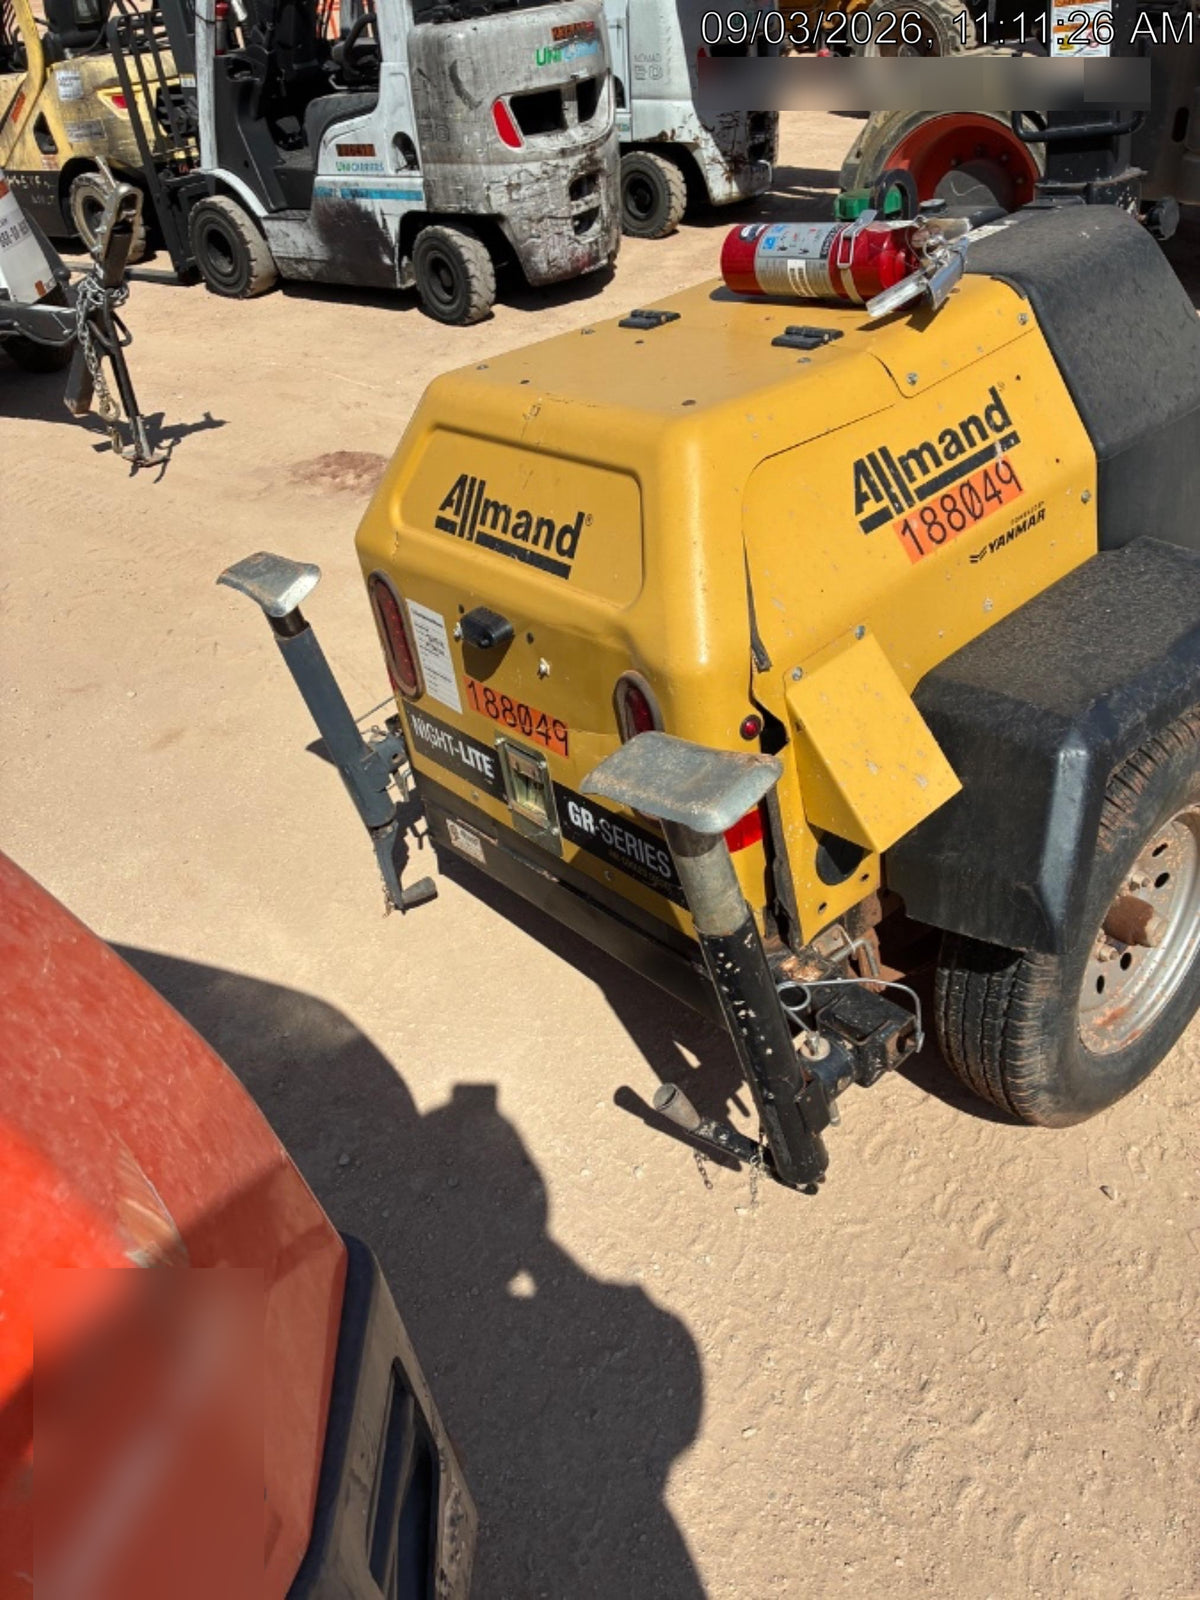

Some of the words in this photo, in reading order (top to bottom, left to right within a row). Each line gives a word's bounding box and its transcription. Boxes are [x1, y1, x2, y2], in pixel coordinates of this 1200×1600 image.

[901, 459, 1023, 556] 188049
[988, 508, 1047, 553] YANMAR
[411, 714, 495, 779] NIGHT-LITE
[468, 681, 568, 756] 188049
[567, 801, 672, 878] GR-SERIES
